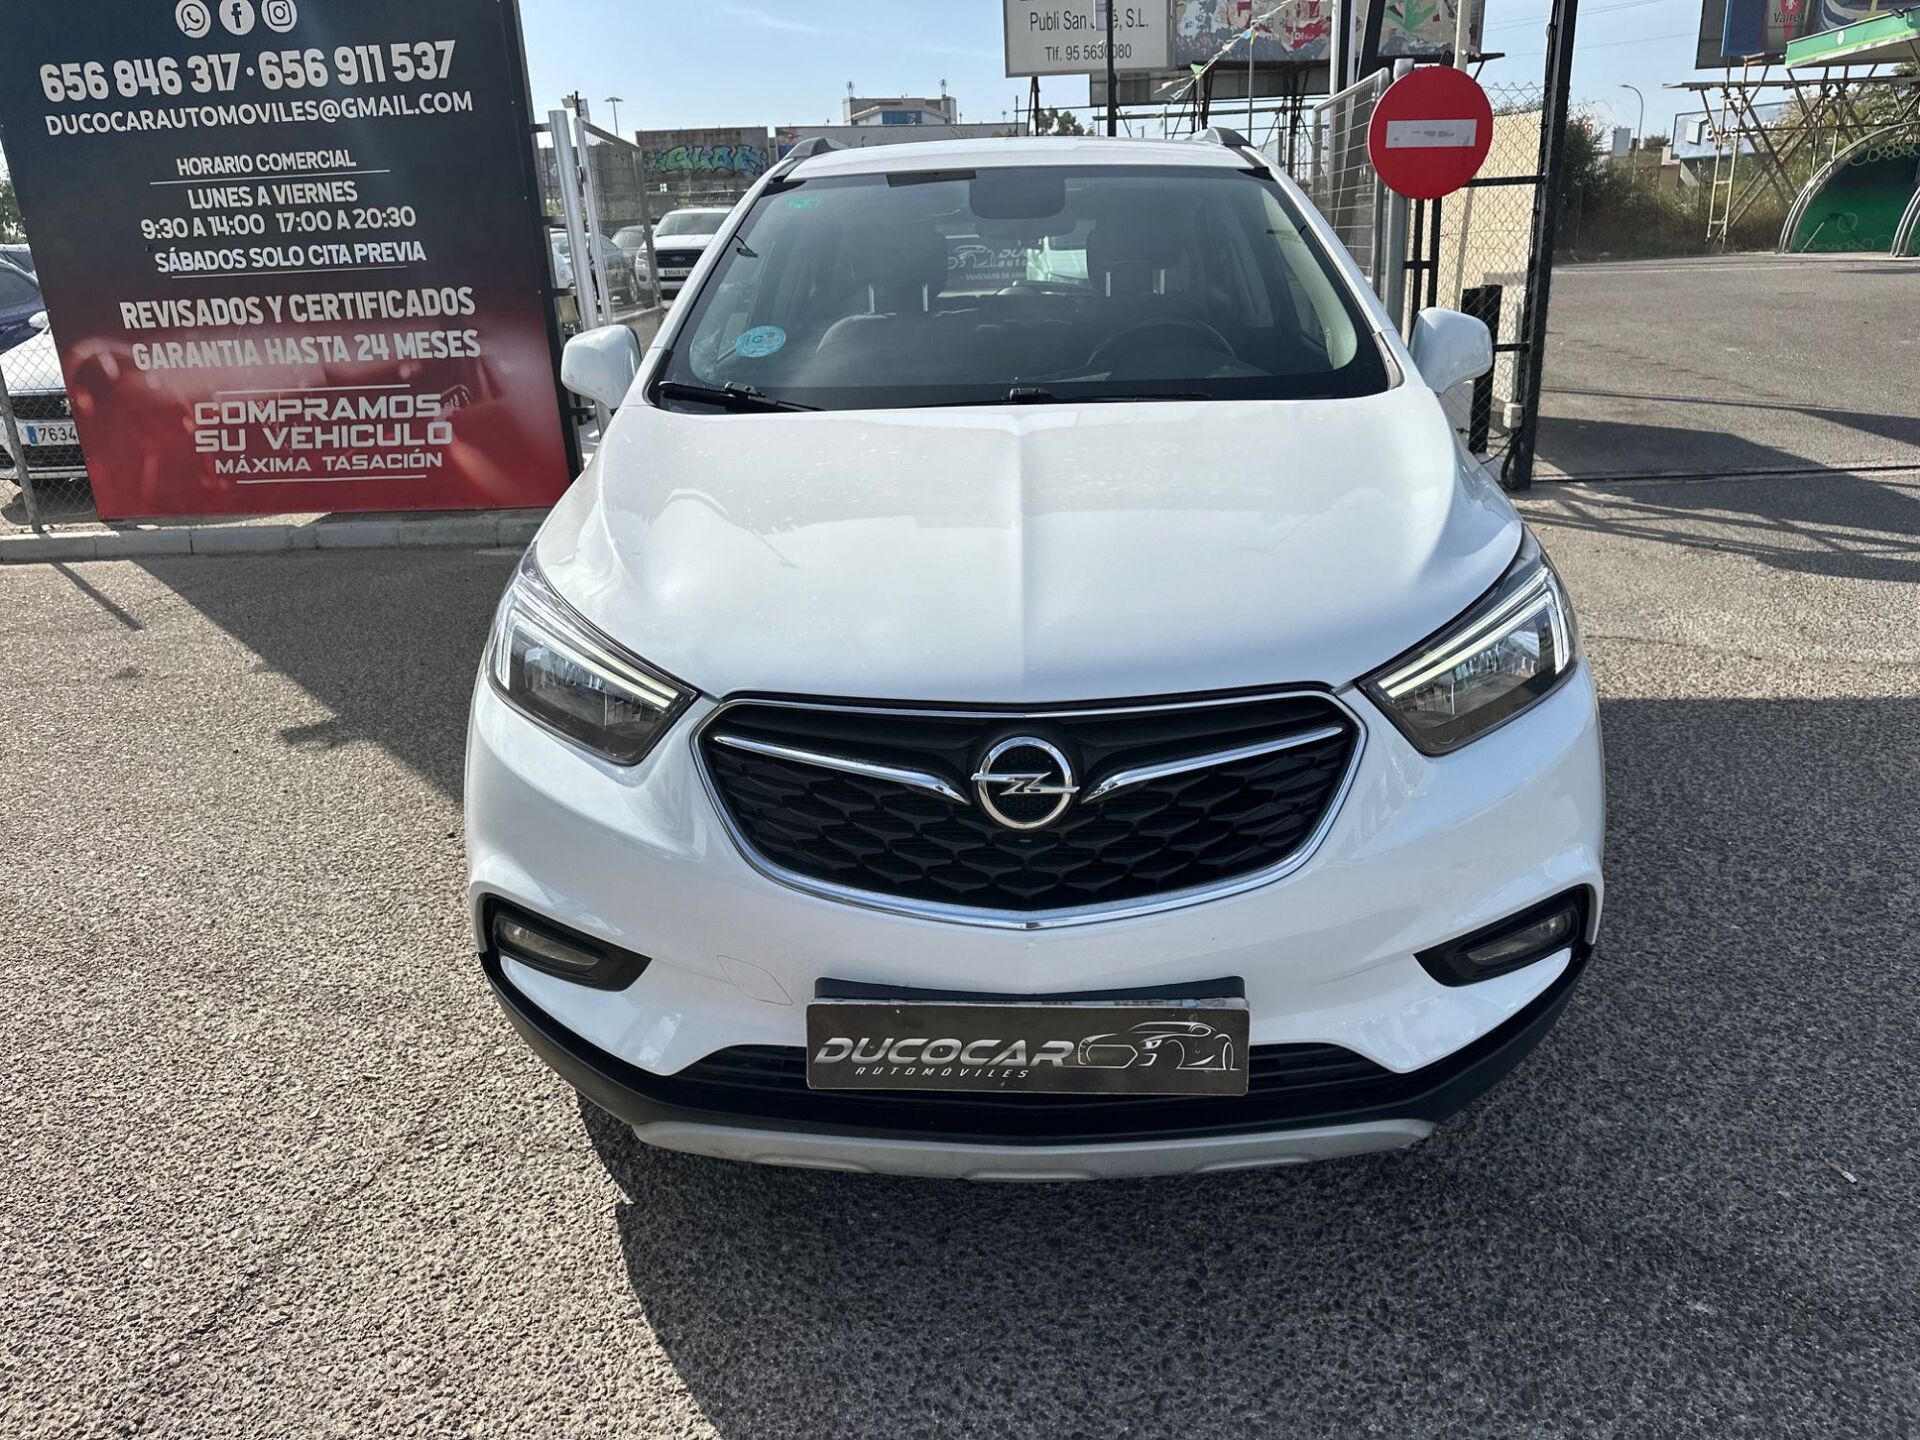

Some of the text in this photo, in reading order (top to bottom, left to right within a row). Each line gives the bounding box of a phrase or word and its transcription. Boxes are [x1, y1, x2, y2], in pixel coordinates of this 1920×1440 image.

[1030, 10, 1060, 31] Publi
[1063, 10, 1087, 30] San
[1125, 8, 1149, 28] S.L.
[1045, 45, 1062, 61] Tlf.
[1065, 45, 1080, 60] 95
[39, 39, 456, 102] 656 846 317 656 911 537
[45, 90, 474, 136] DUCOCARAUTOMOVILES@GMAIL.COM
[176, 149, 357, 176] HORARIO COMERCIAL
[187, 180, 358, 209] LUNES A VIERNES
[140, 205, 417, 240] 9:30 A 14:00 17:00 A 20:30
[154, 240, 427, 273] SÁBADOS SOLO CITA PREVIA
[119, 286, 476, 329] REVISADOS Y CERTIFICADOS
[132, 329, 482, 371] GARANTIA HASTA 24 MESES
[194, 393, 442, 426] COMPRAMOS
[38, 426, 77, 441] 7634
[195, 421, 453, 453] SU VEHICULO
[215, 448, 443, 474] MÁXIMA TASACIÓN
[813, 1037, 1075, 1067] DUCOCAR
[855, 1065, 1029, 1078] AUTOMÓVILES
